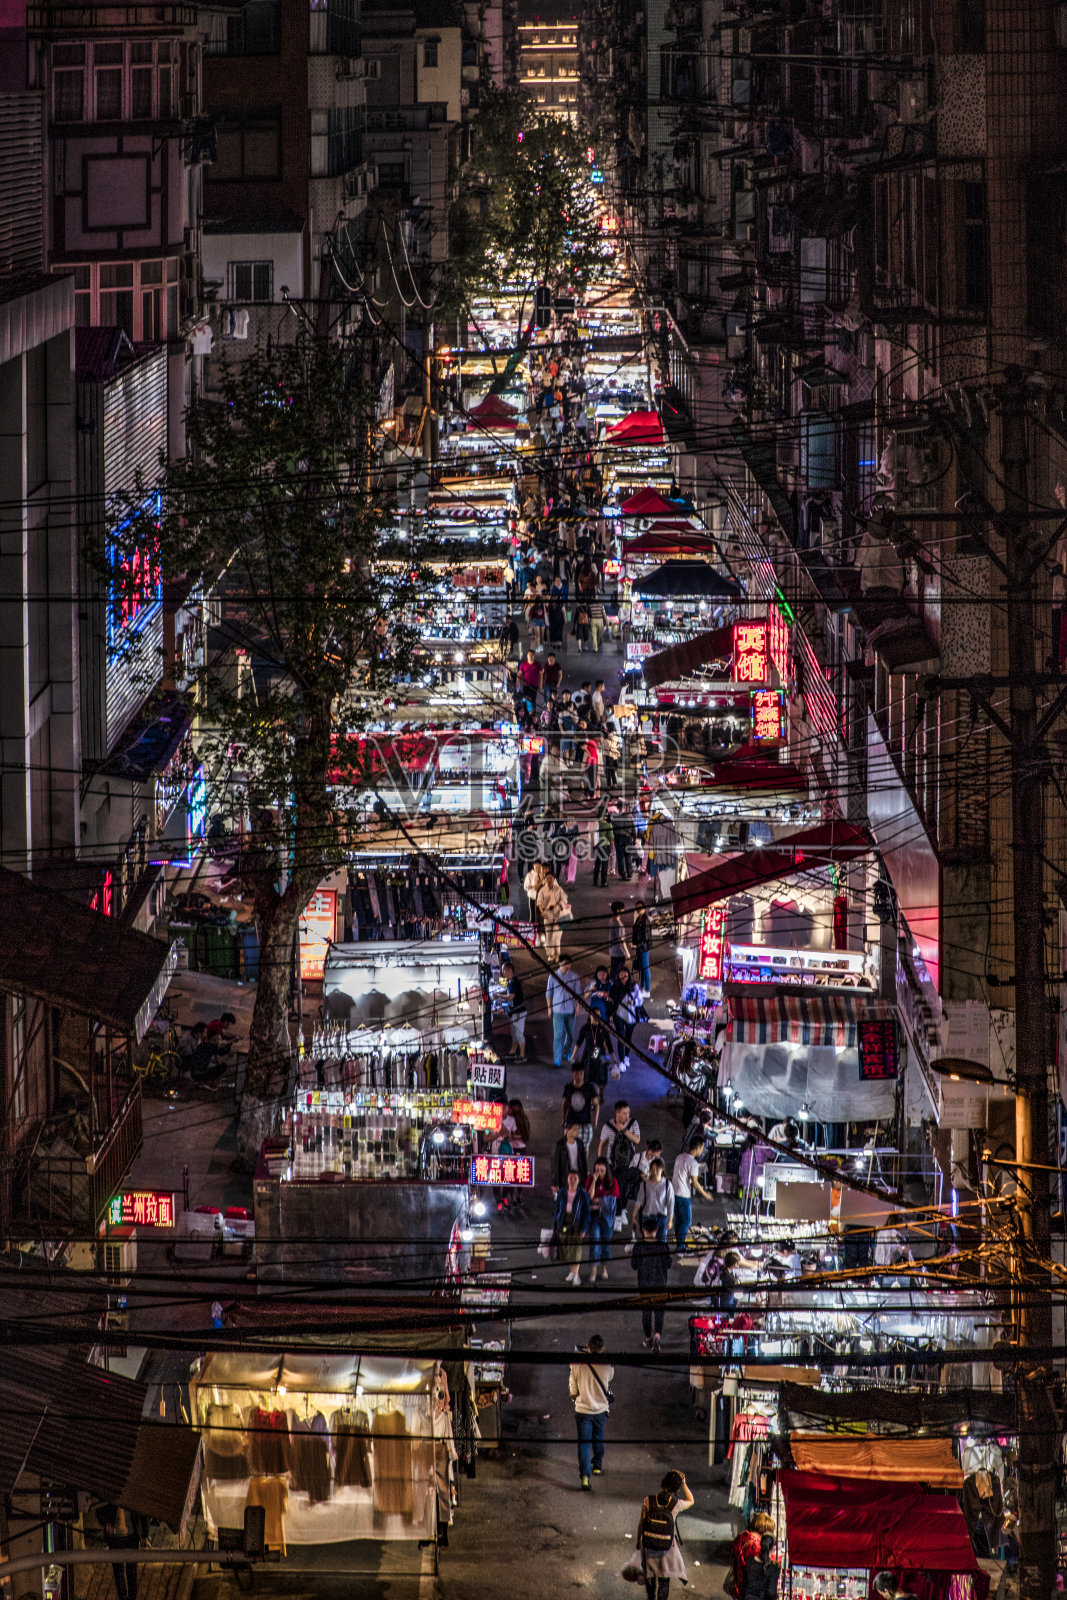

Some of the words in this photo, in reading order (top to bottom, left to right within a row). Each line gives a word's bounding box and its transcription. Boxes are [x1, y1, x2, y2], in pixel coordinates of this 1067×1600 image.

[737, 625, 765, 681] 宾馆
[703, 909, 721, 978] 化妆品
[474, 1066, 502, 1085] 贴膜
[475, 1156, 531, 1184] 精品童鞋
[122, 1194, 171, 1224] 兰州拉面
